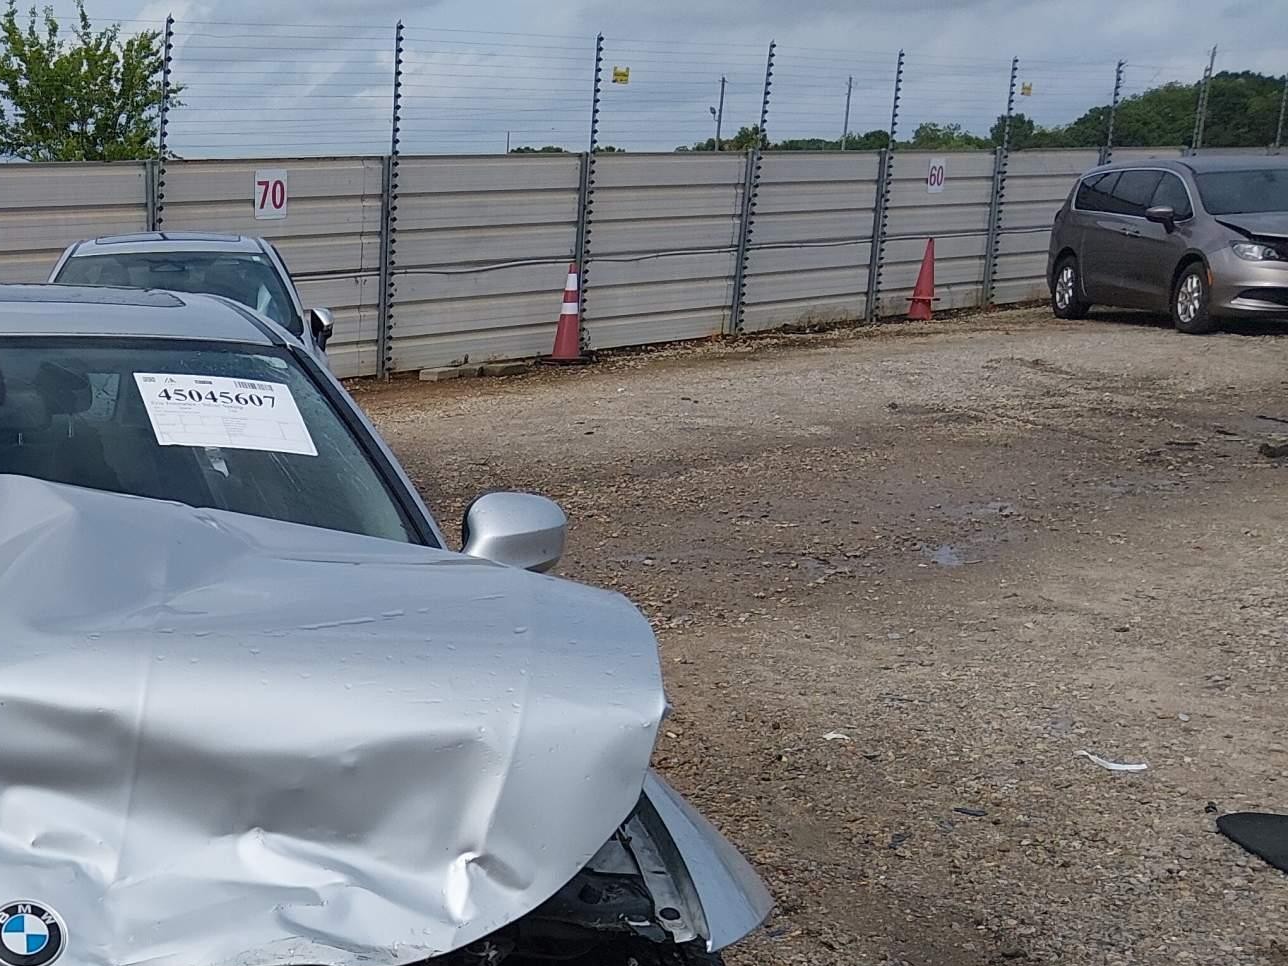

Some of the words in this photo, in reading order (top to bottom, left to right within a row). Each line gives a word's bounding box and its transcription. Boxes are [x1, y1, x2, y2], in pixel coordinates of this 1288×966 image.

[929, 165, 944, 186] 60
[257, 179, 285, 210] 70
[158, 388, 275, 409] 45045607
